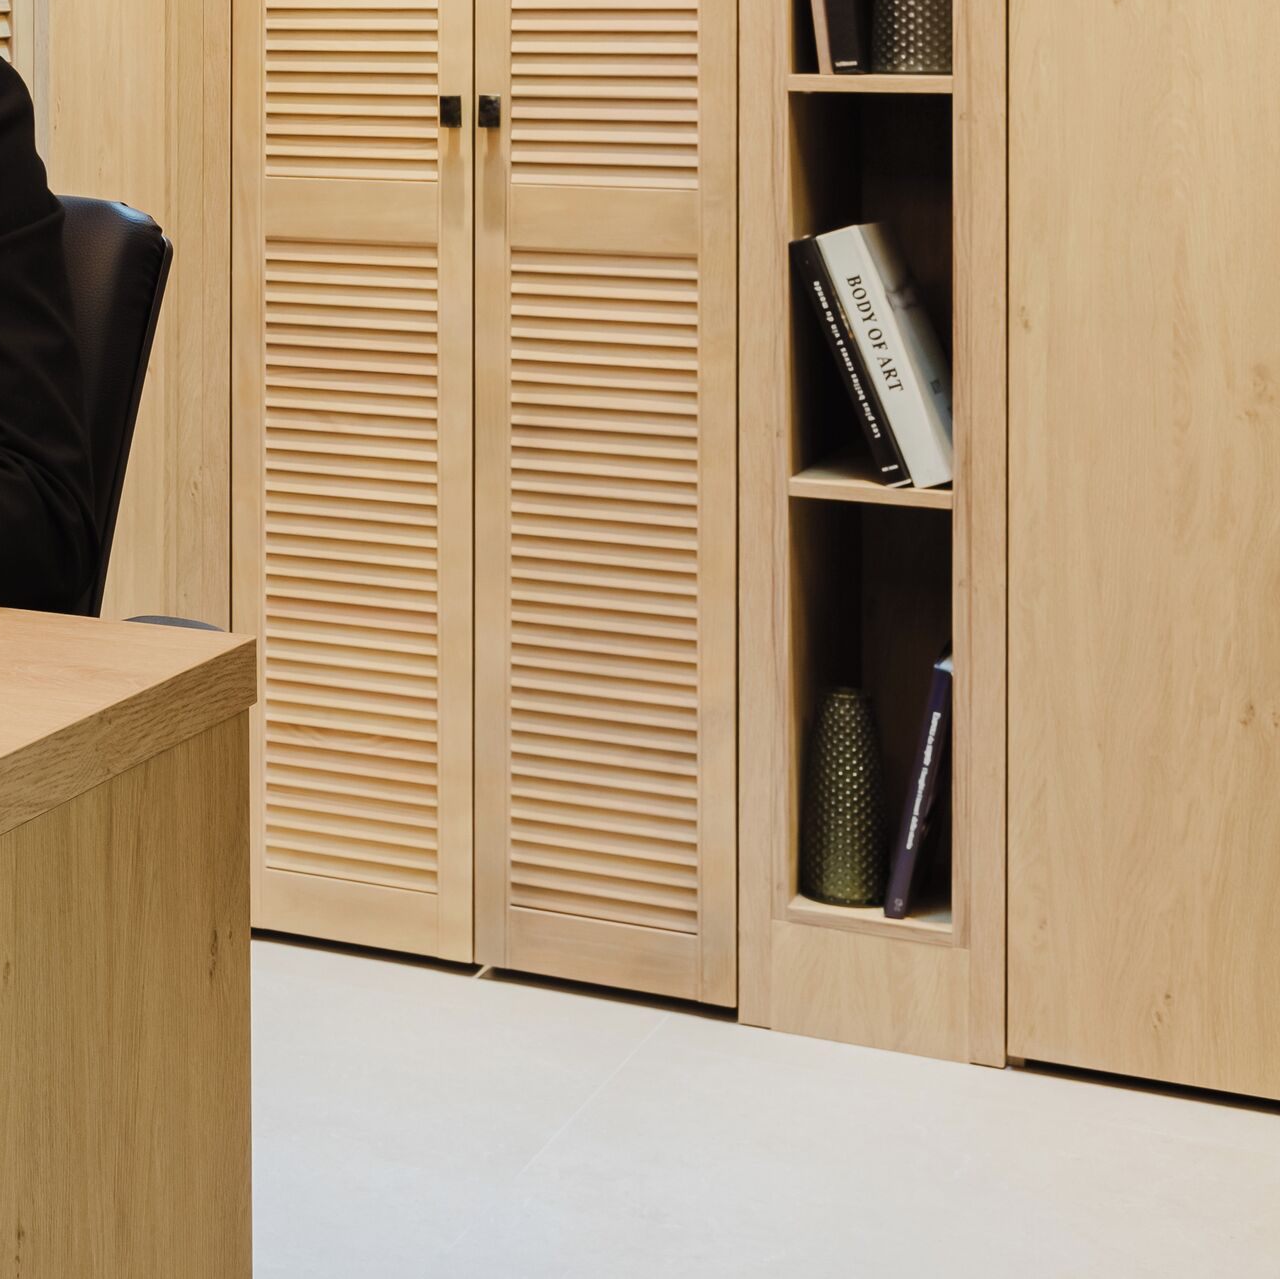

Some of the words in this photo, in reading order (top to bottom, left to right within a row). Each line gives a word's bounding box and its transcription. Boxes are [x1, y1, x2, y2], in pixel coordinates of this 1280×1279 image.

[813, 280, 829, 309] monde
[846, 275, 878, 323] BODY
[825, 310, 835, 322] du
[830, 324, 840, 338] vin
[867, 328, 888, 351] OF
[840, 347, 855, 372] caves
[877, 355, 905, 392] ART
[851, 373, 866, 401] belles
[862, 402, 876, 421] plus
[870, 422, 881, 439] Les
